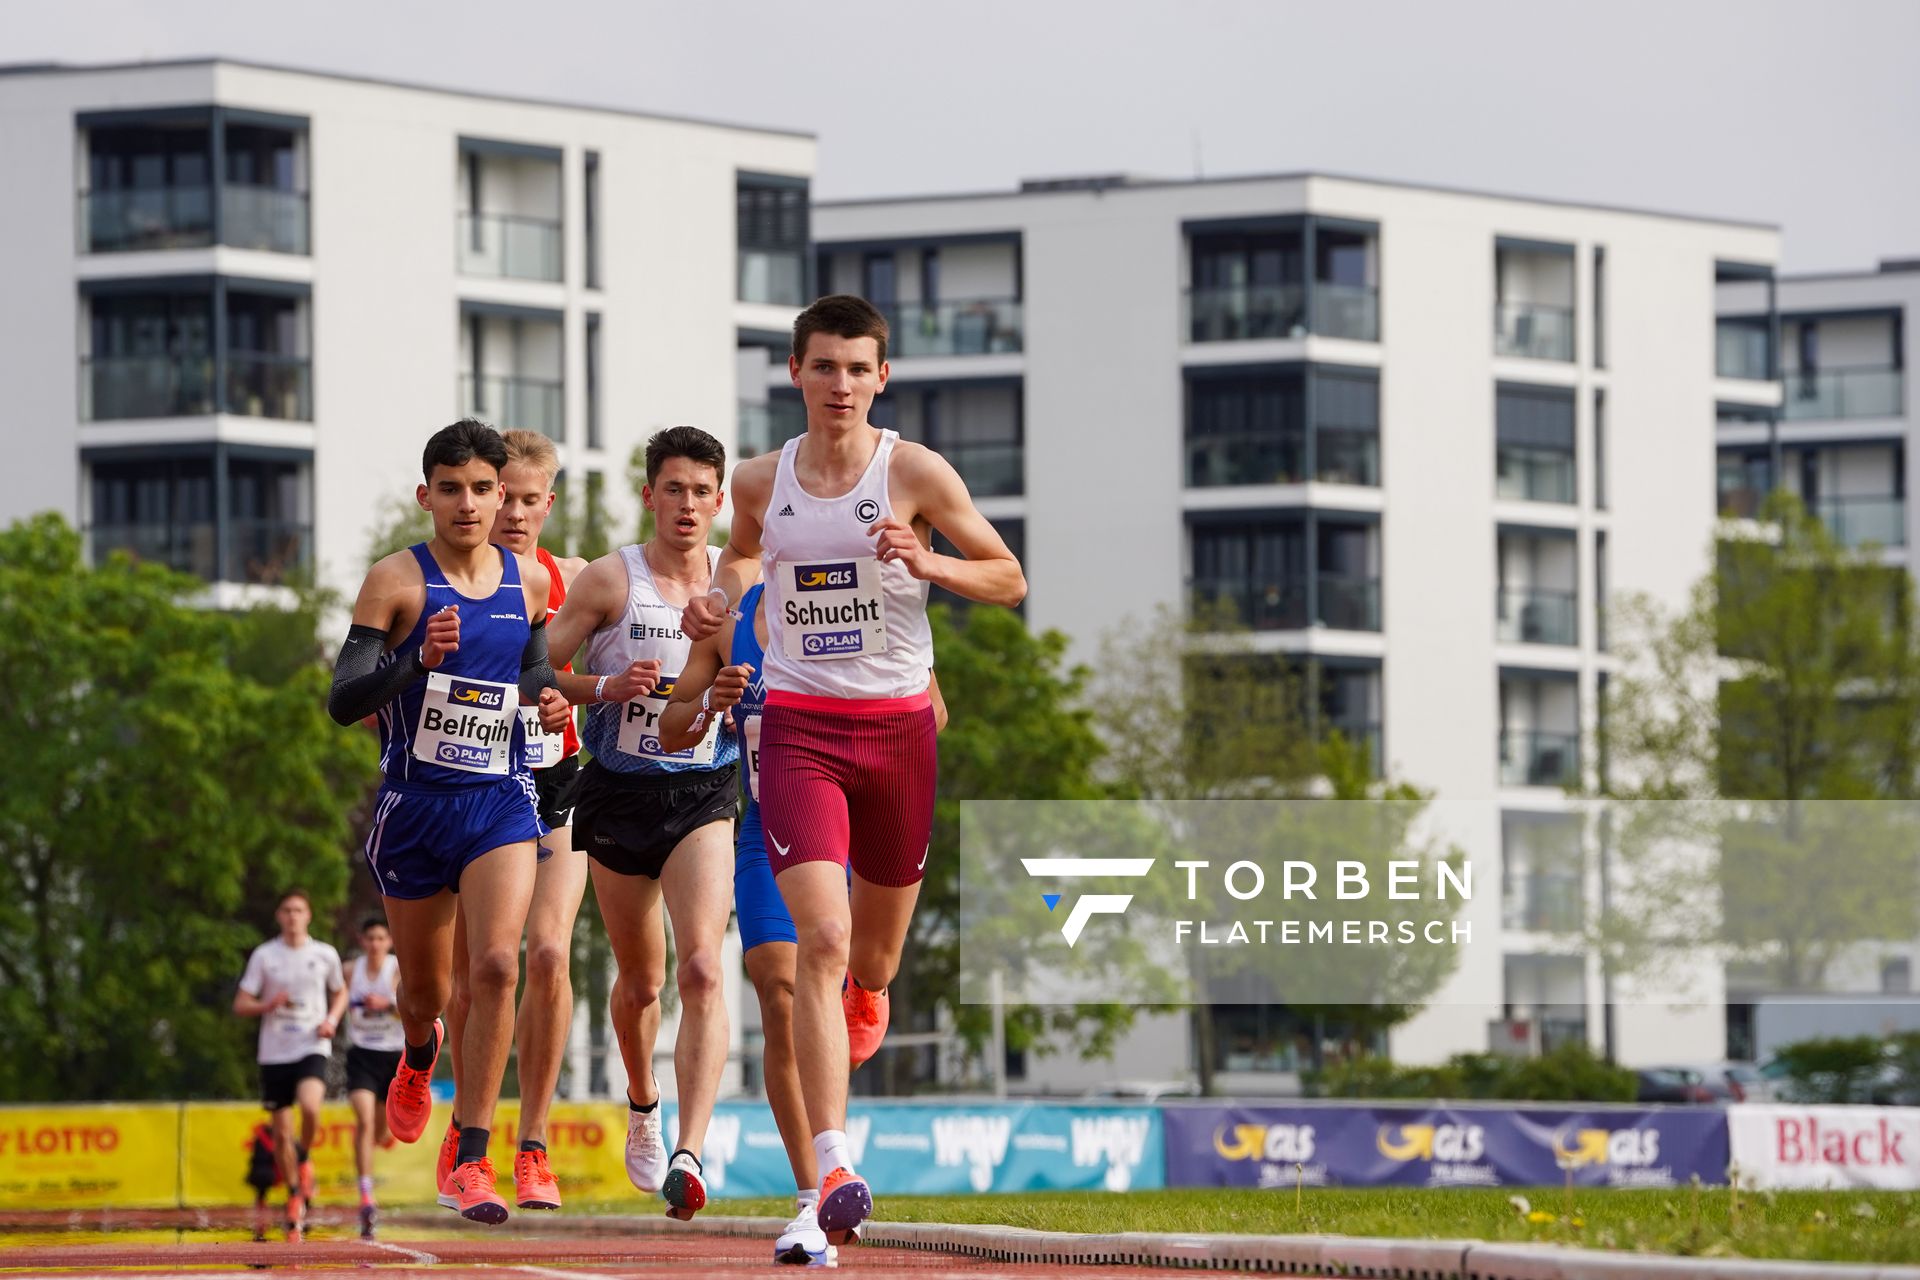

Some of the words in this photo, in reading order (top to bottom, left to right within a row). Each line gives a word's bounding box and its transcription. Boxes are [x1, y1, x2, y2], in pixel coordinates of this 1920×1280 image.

[827, 570, 852, 585] GLS
[785, 597, 880, 626] Schucht
[648, 627, 683, 640] TELIS
[825, 634, 860, 646] PLAN
[478, 692, 502, 706] GLS
[423, 707, 509, 746] Belfqih
[460, 748, 490, 762] PLAN
[17, 1124, 119, 1154] LOTTO
[505, 1122, 605, 1149] LTTO
[1264, 1123, 1316, 1162] GLS
[1432, 1123, 1485, 1162] GLS
[1775, 1114, 1905, 1167] Black
